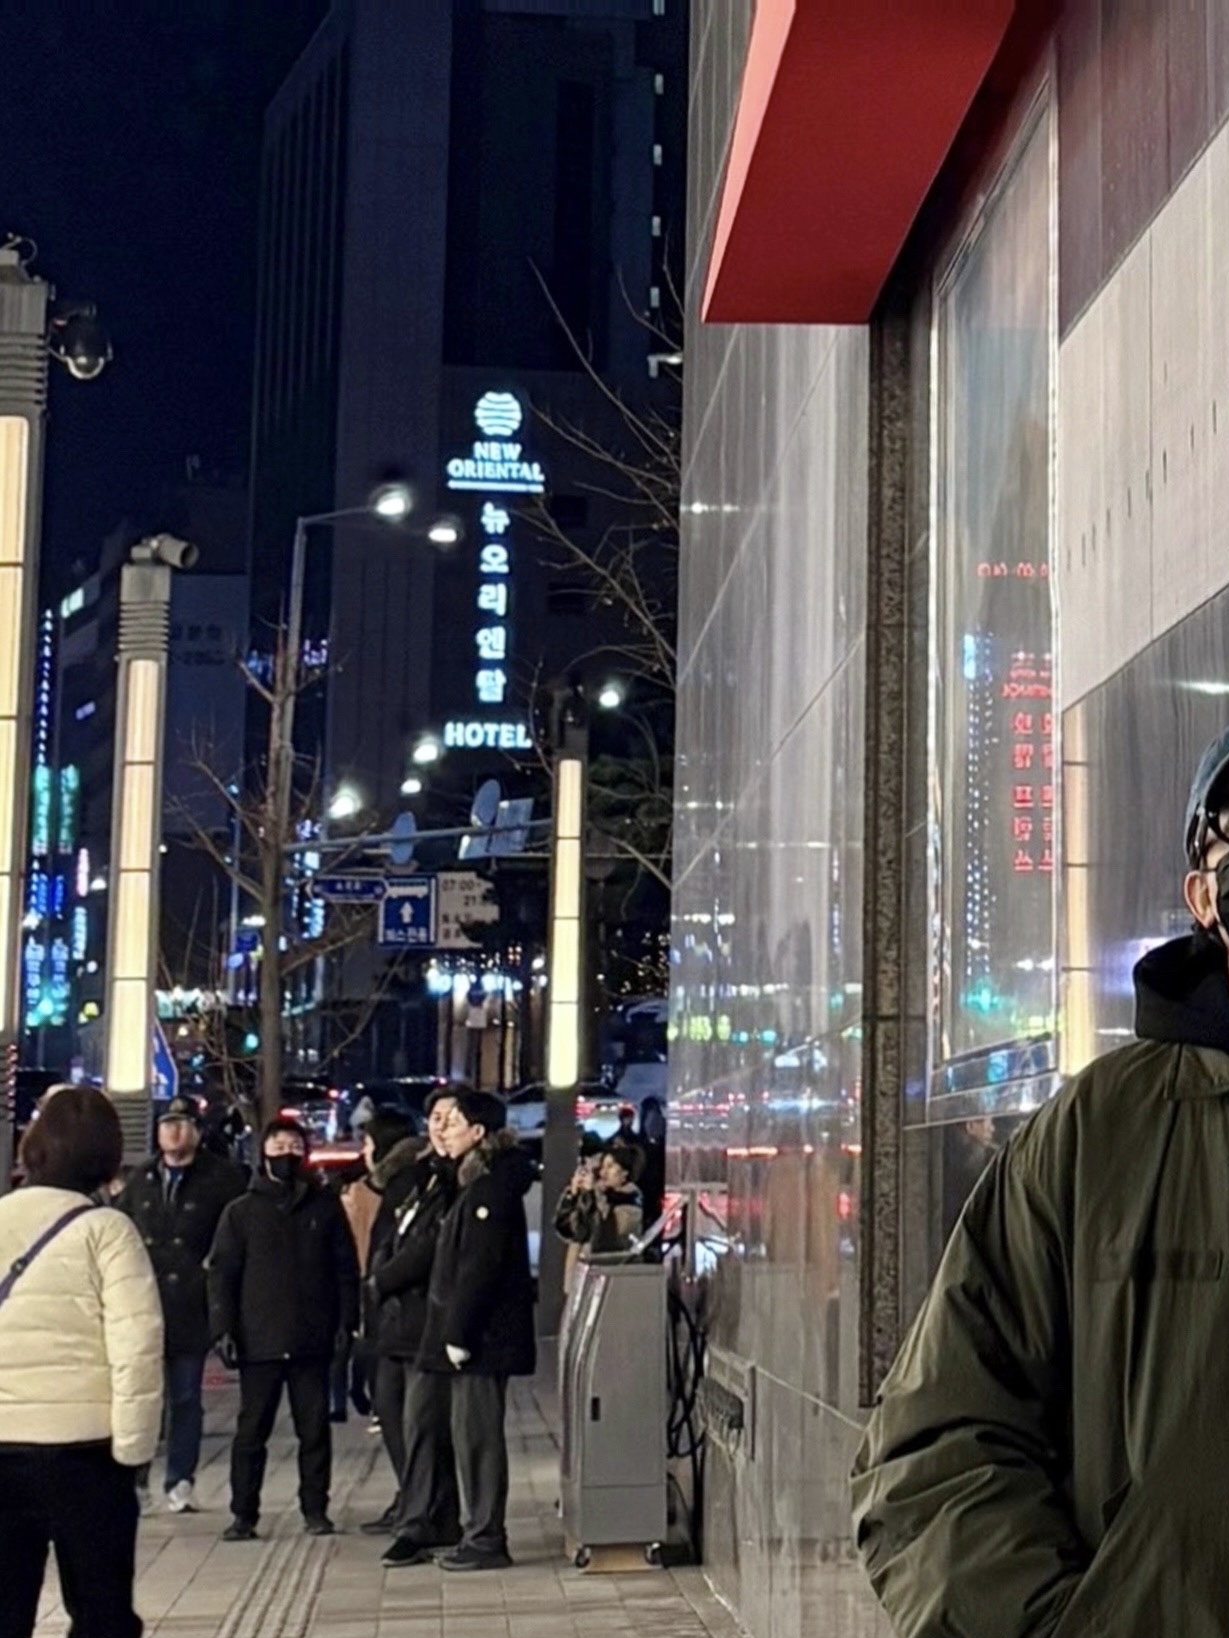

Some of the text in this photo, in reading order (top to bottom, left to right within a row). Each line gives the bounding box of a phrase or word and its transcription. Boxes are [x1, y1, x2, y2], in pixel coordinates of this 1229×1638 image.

[473, 441, 522, 461] NEW
[446, 458, 545, 481] ORIENTAL
[475, 501, 510, 702] 뉴오리엔탈
[444, 721, 533, 748] HOTEL
